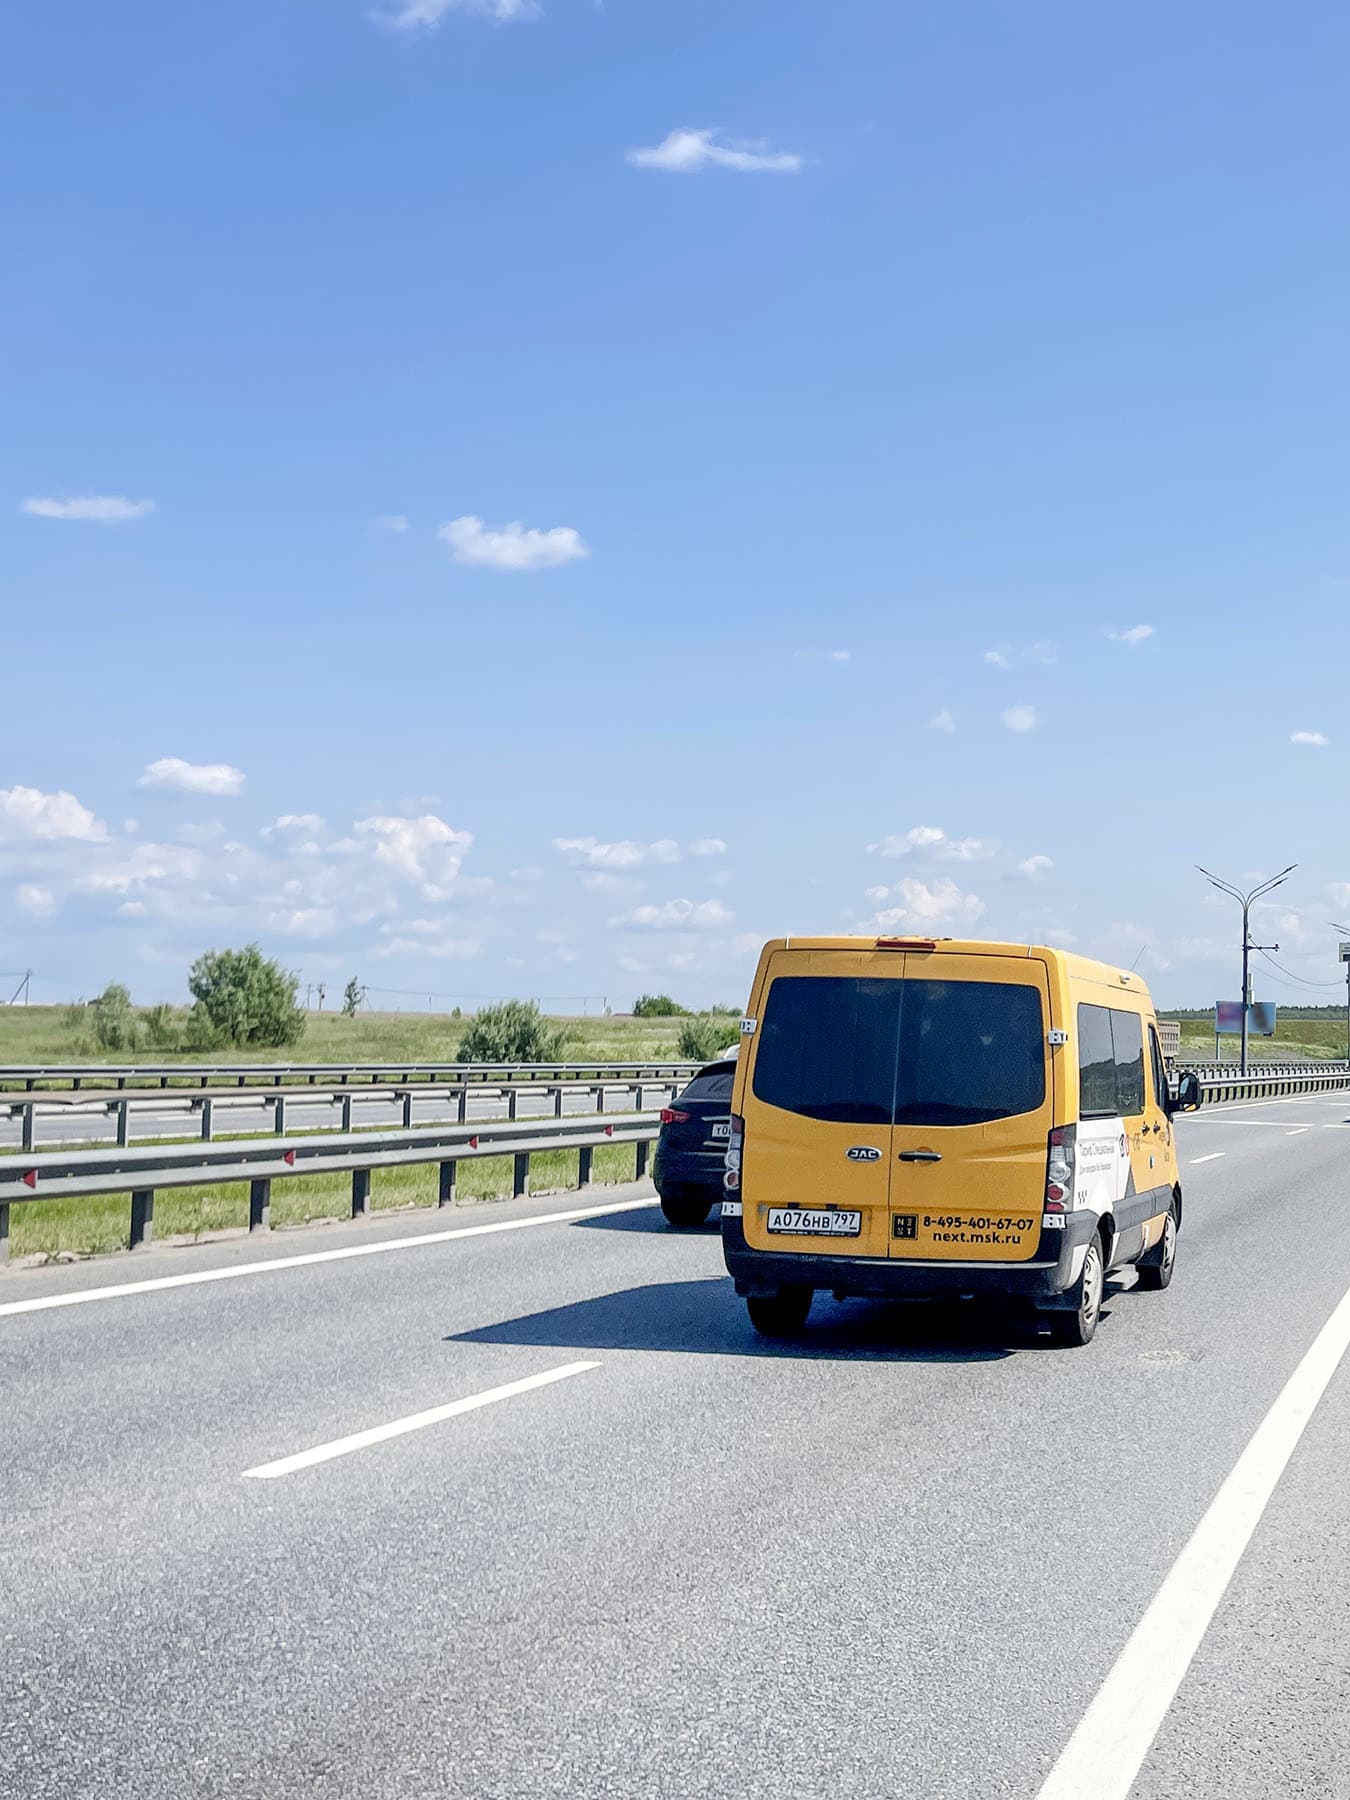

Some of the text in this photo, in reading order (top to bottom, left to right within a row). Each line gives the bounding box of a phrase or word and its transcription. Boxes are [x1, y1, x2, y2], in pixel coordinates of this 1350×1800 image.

[850, 1150, 877, 1158] JAC
[834, 1213, 856, 1226] 797
[923, 1215, 1034, 1231] 8-495-401-67-07
[933, 1232, 1021, 1244] next.msk.ru
